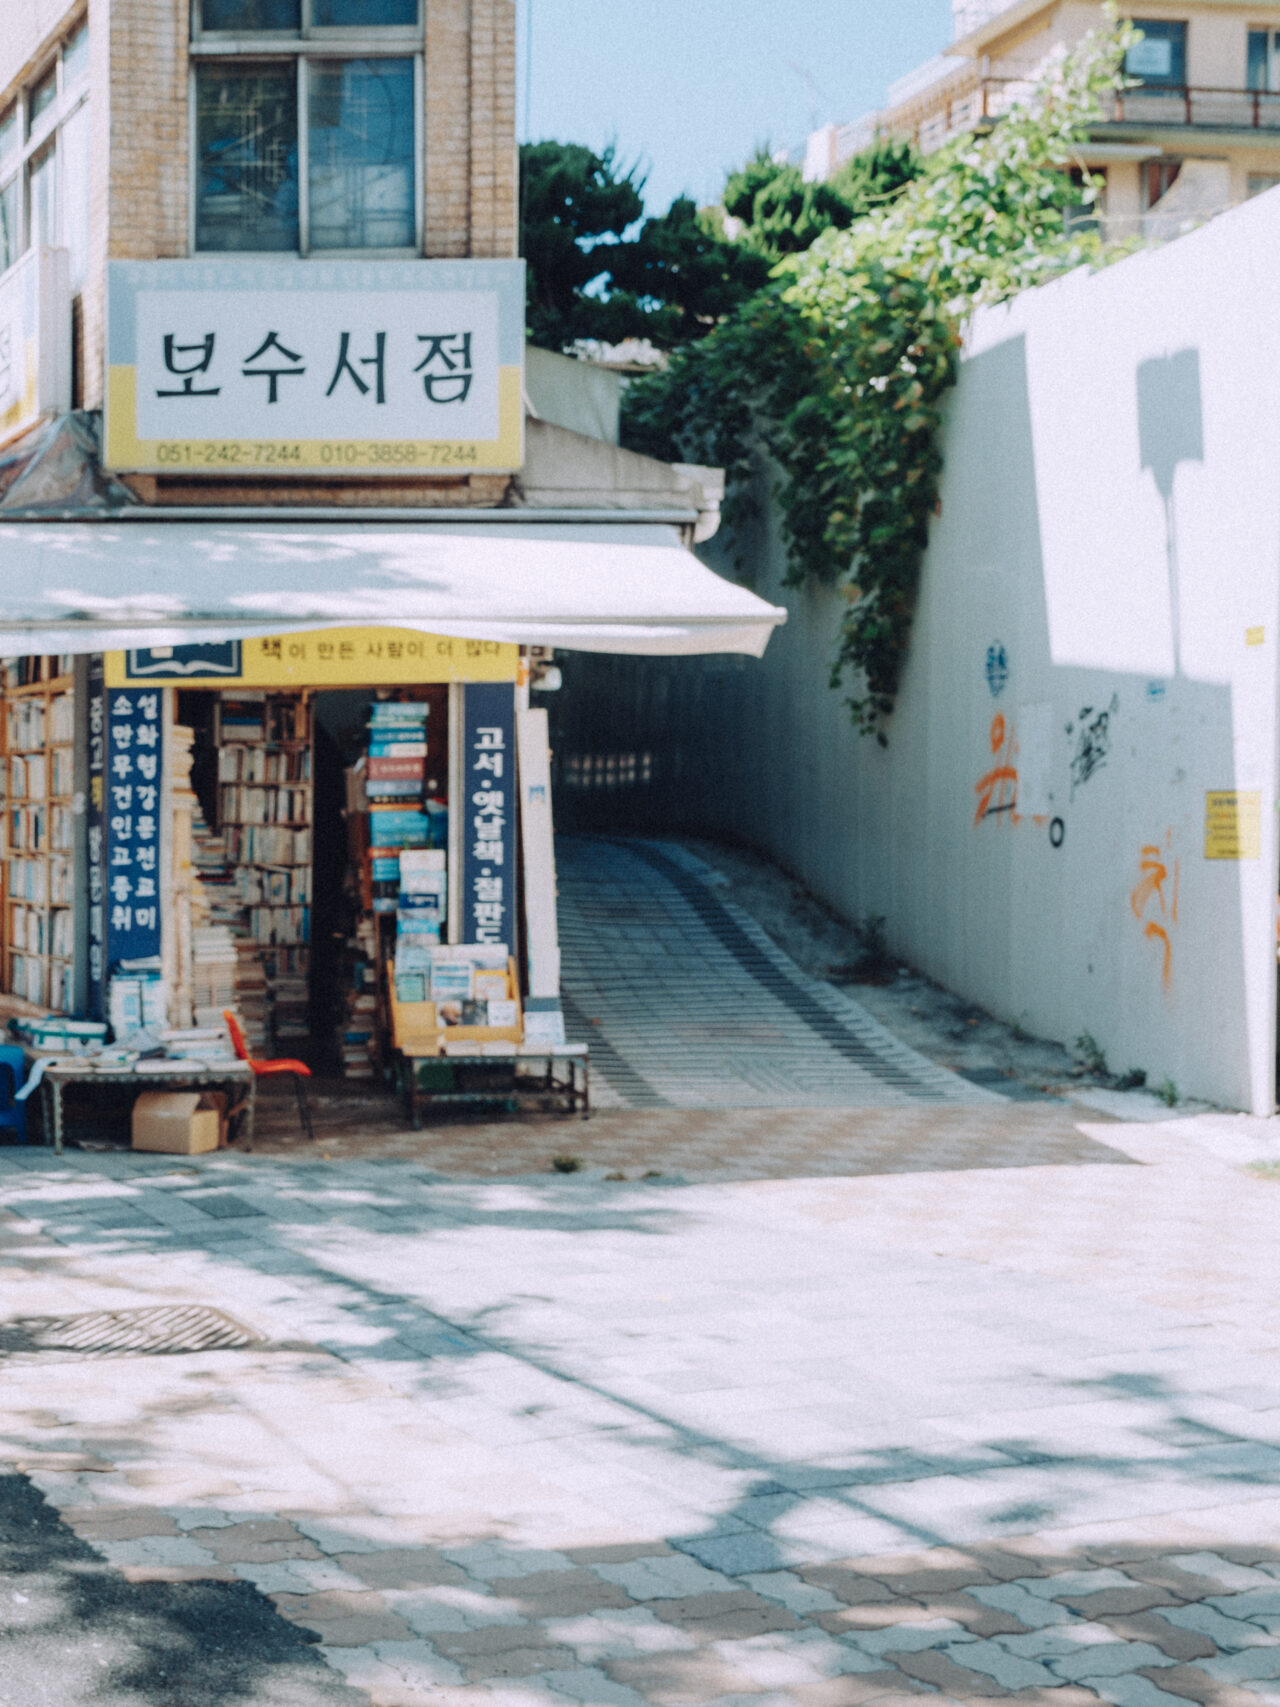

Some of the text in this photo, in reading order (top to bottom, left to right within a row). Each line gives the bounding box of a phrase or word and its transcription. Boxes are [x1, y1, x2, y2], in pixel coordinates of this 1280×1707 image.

[156, 331, 474, 404] 보수서점
[156, 444, 477, 464] 051-242-7244 010-3858-7244
[317, 641, 354, 661] 만든
[366, 640, 425, 660] 사람이
